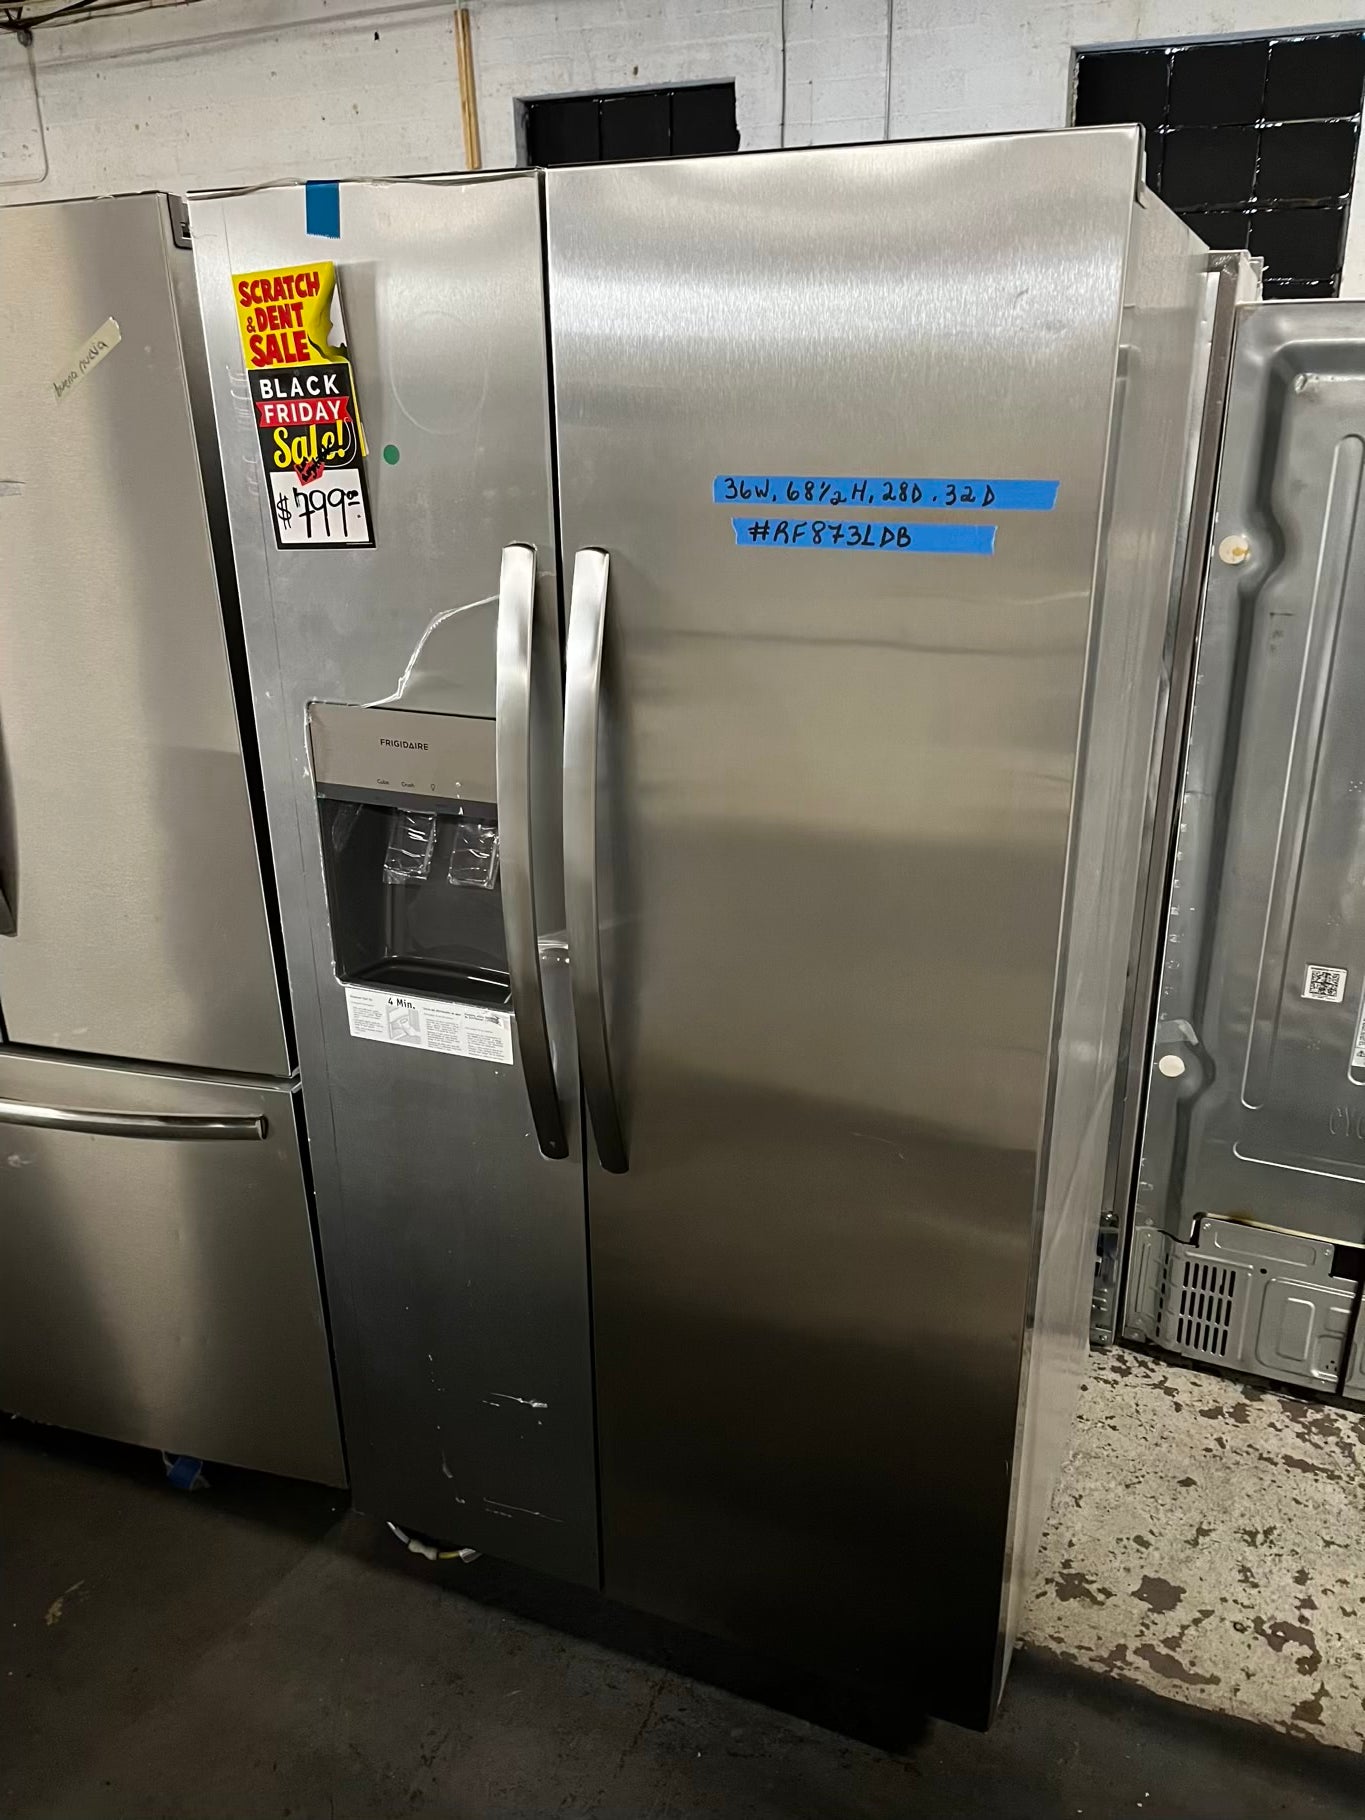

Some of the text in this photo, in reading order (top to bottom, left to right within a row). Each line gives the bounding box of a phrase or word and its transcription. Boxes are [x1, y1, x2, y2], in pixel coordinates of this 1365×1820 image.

[238, 271, 320, 307] SCRATCH
[249, 330, 311, 367] SALE
[259, 374, 340, 399] BLACK
[264, 400, 341, 424] FRIDAY
[273, 419, 346, 468] Sale!
[380, 738, 429, 751] FRIGIDAIRE
[387, 997, 393, 1006] 4
[396, 998, 416, 1010] Min.
